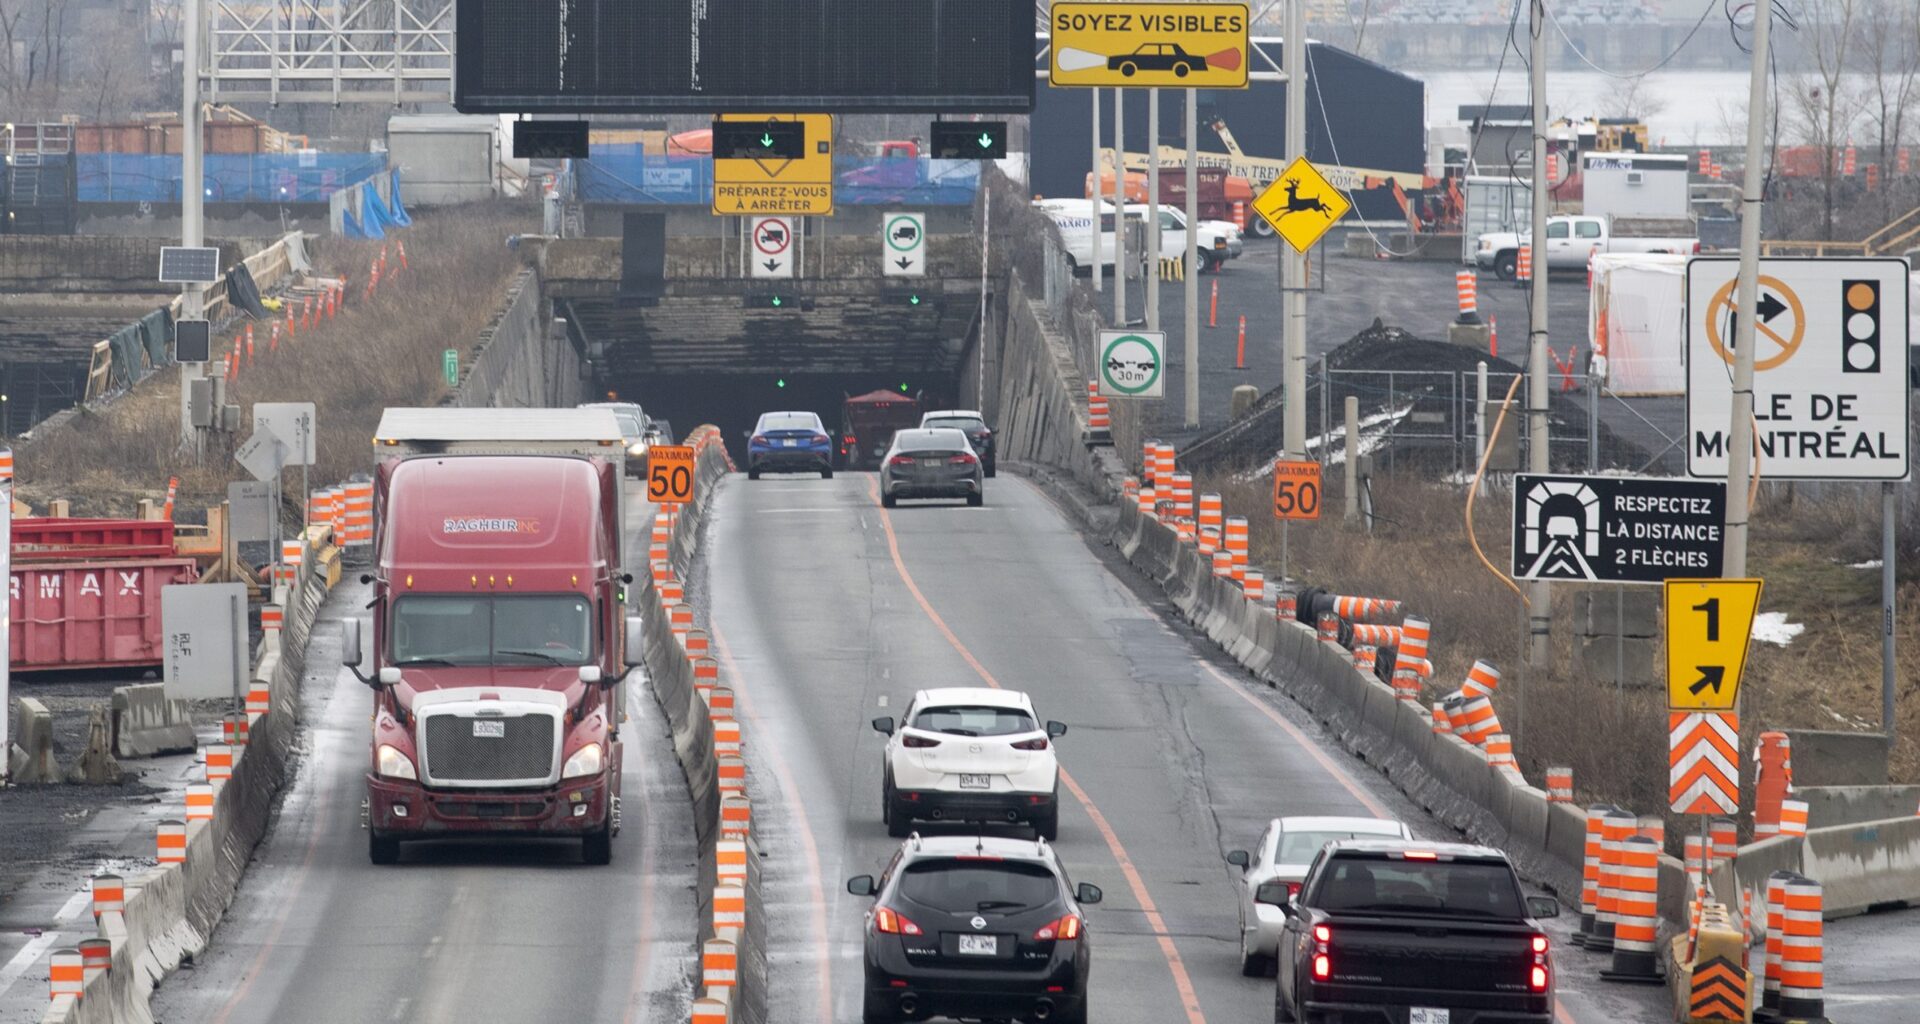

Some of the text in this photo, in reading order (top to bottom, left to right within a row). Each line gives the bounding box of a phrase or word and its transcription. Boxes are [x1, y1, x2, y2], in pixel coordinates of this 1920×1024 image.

[1057, 14, 1242, 33] SOYEZ VISIBLES
[1252, 165, 1284, 180] TREM
[719, 185, 828, 197] PRÉPAREZ-VOUS
[736, 198, 811, 210] À ARRÊTER
[1058, 218, 1091, 229] MARD
[1118, 371, 1144, 381] 30 m
[1752, 394, 1858, 421] LE DE
[651, 451, 693, 461] MAXIMUM
[650, 465, 691, 498] 50
[1276, 481, 1318, 514] 50
[1614, 495, 1712, 515] RESPECTEZ
[1634, 522, 1719, 541] DISTANCE
[1615, 545, 1709, 568] 2 FLÈCHES
[1692, 598, 1719, 642] 1
